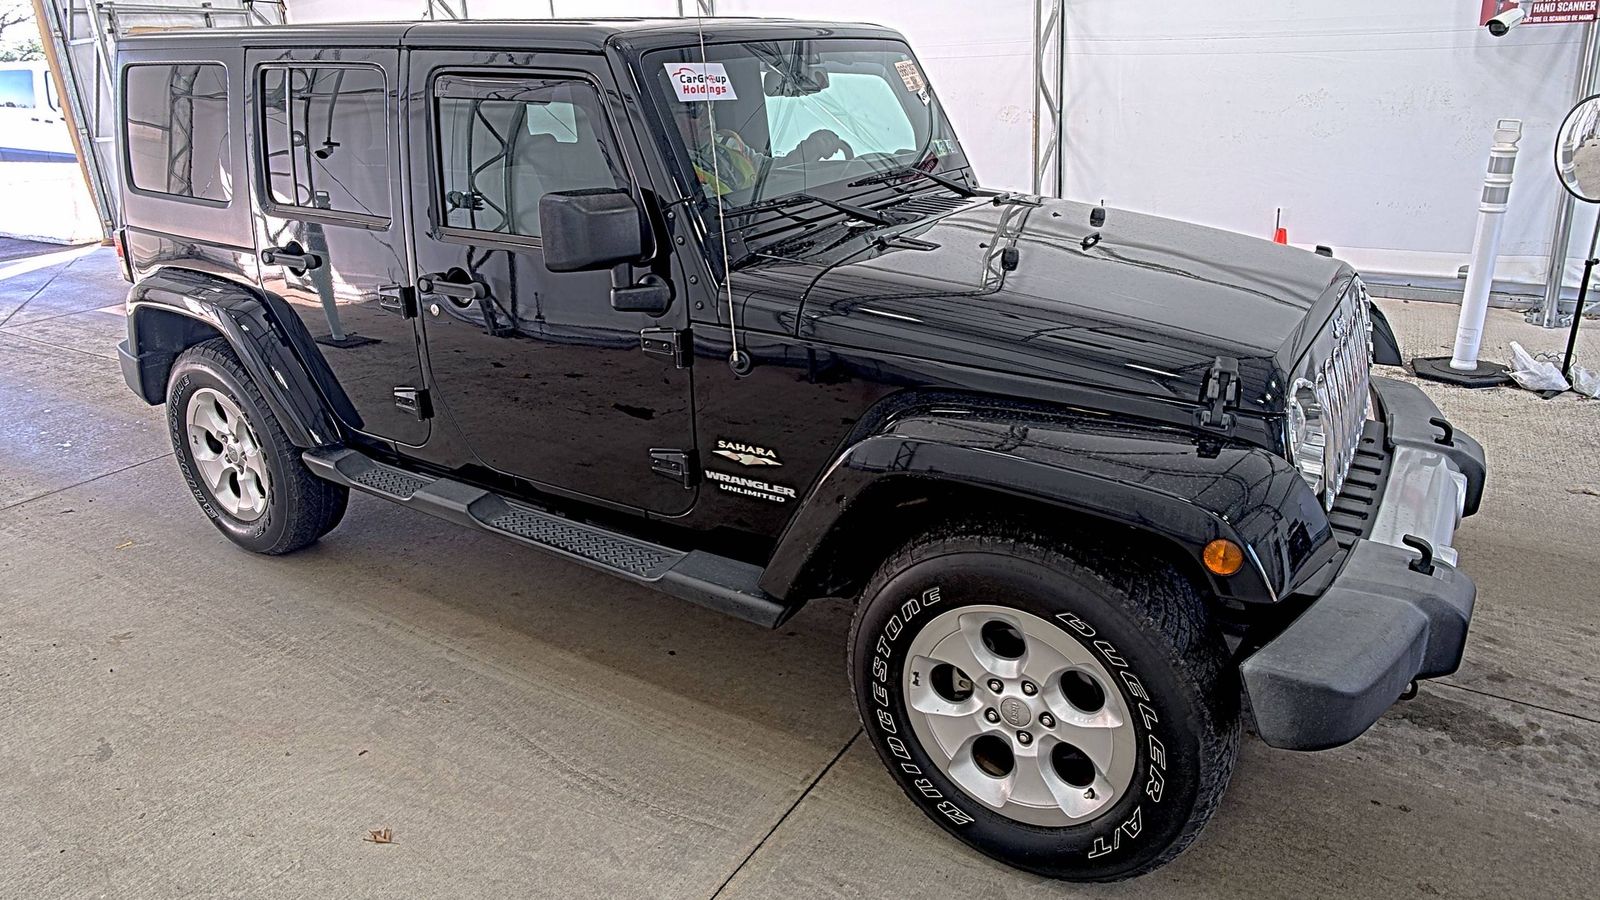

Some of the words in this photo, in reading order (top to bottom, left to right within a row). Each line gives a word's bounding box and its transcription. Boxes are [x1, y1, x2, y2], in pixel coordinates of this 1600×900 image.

[1533, 3, 1556, 13] HAND
[1557, 1, 1596, 12] SCANNER
[679, 74, 727, 85] CarGroup
[683, 85, 727, 95] Holdings
[718, 440, 776, 458] SAHARA
[705, 470, 796, 498] WRANGLER
[719, 484, 785, 503] UNLIMITED
[872, 586, 975, 825] BRIDGESTONE
[1056, 612, 1167, 803] DUELER
[1088, 805, 1143, 859] A/T
